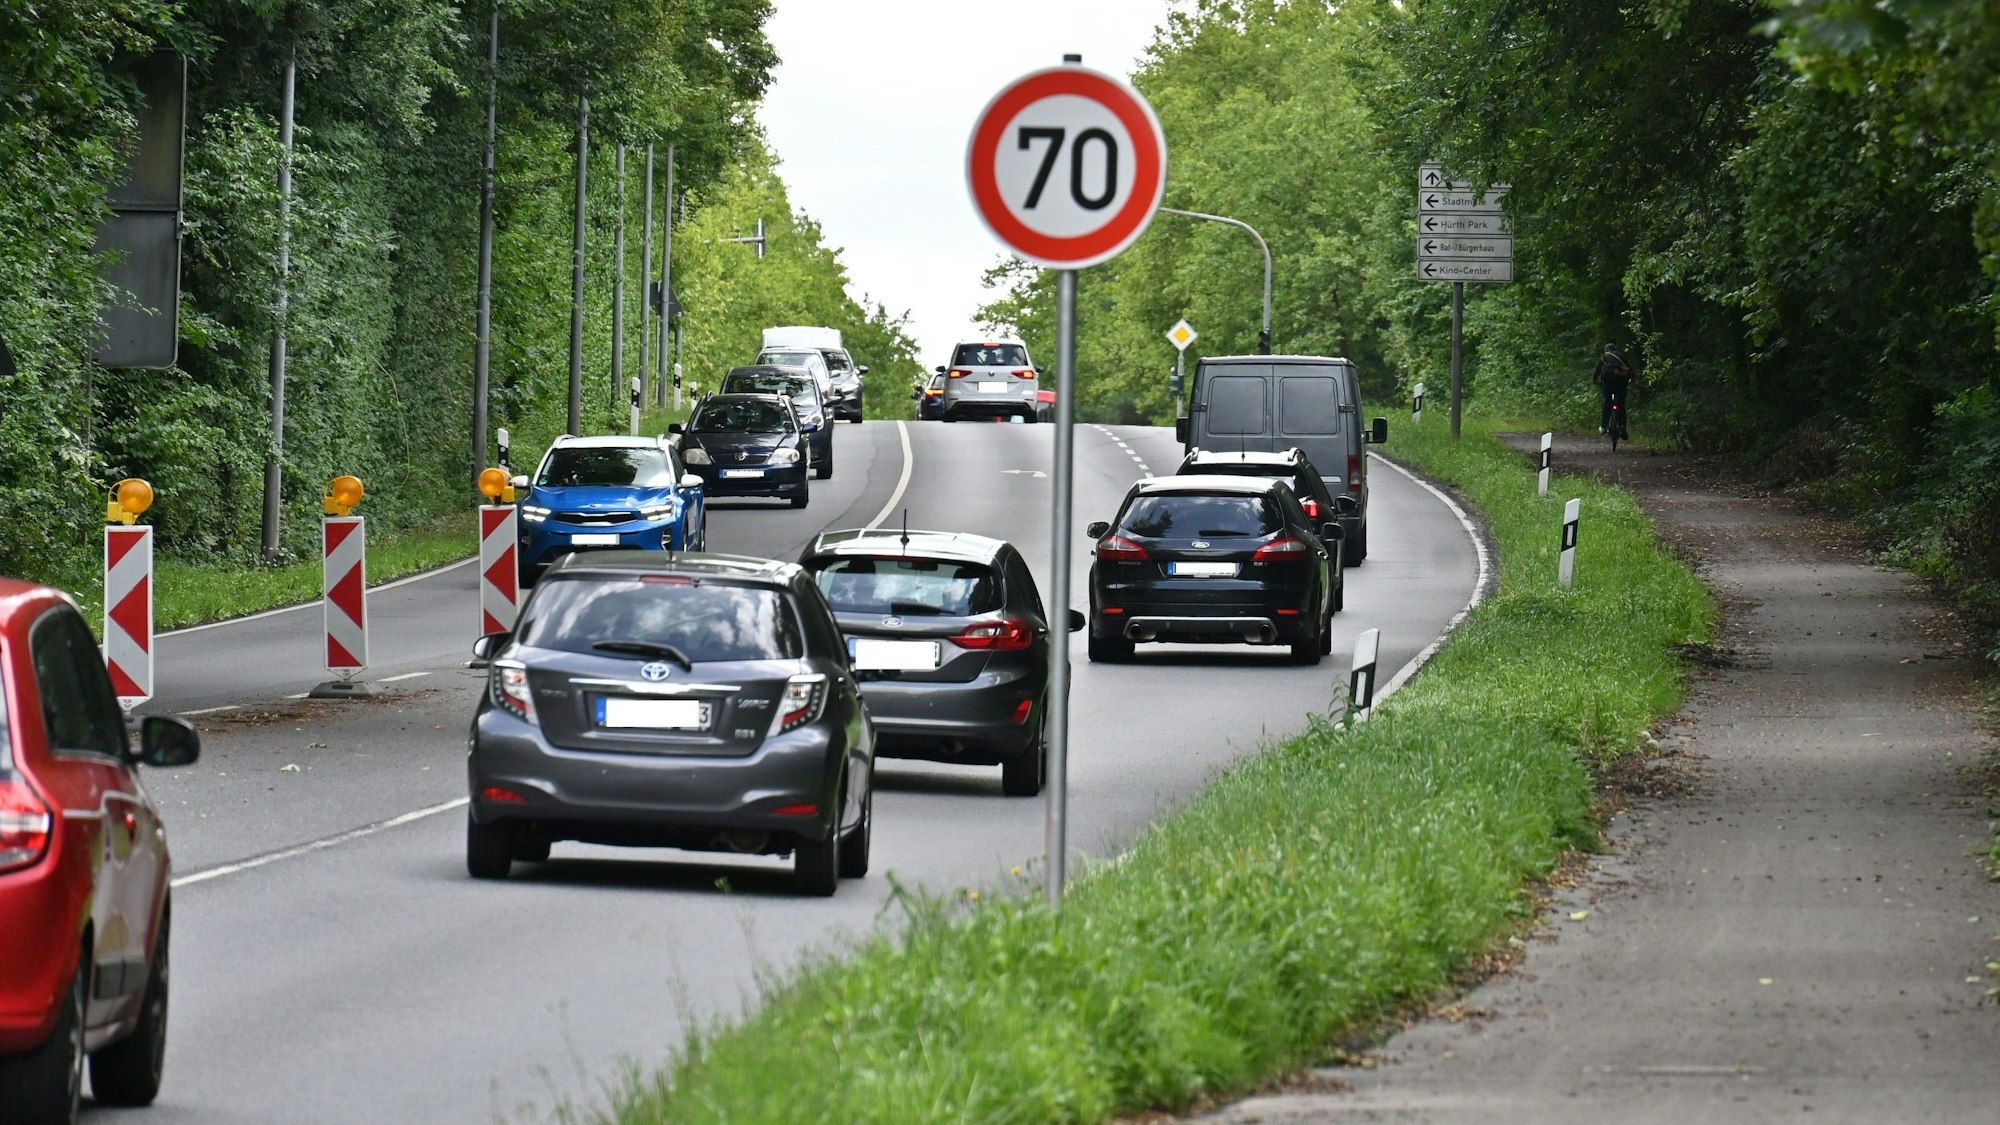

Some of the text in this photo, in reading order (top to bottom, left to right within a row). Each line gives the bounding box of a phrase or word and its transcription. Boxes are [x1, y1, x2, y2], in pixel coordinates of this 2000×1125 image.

[1018, 127, 1118, 211] 70
[1441, 220, 1488, 229] Hürth Park
[1439, 267, 1491, 275] Kino-Center
